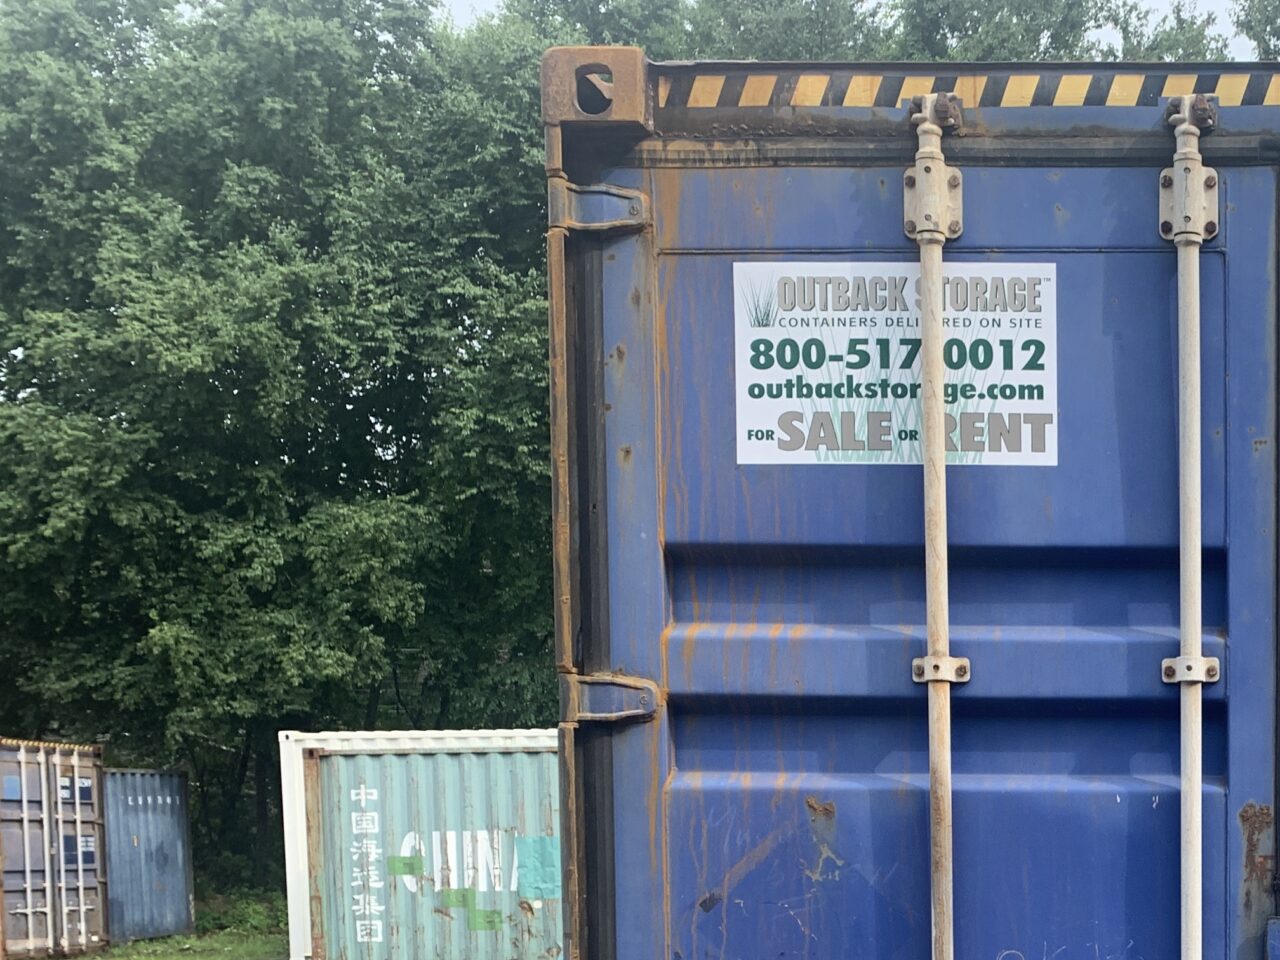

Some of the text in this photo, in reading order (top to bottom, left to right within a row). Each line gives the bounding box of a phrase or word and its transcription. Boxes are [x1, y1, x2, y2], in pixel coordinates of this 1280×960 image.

[777, 276, 909, 312] OUTBACK
[778, 317, 1043, 328] CONTAINERS DELIRED ON SITE
[750, 338, 1045, 371] 800-5170012
[748, 375, 1045, 404] outbackstorge.com
[747, 430, 775, 441] FOR
[777, 410, 892, 452] SALE
[898, 430, 918, 441] OR
